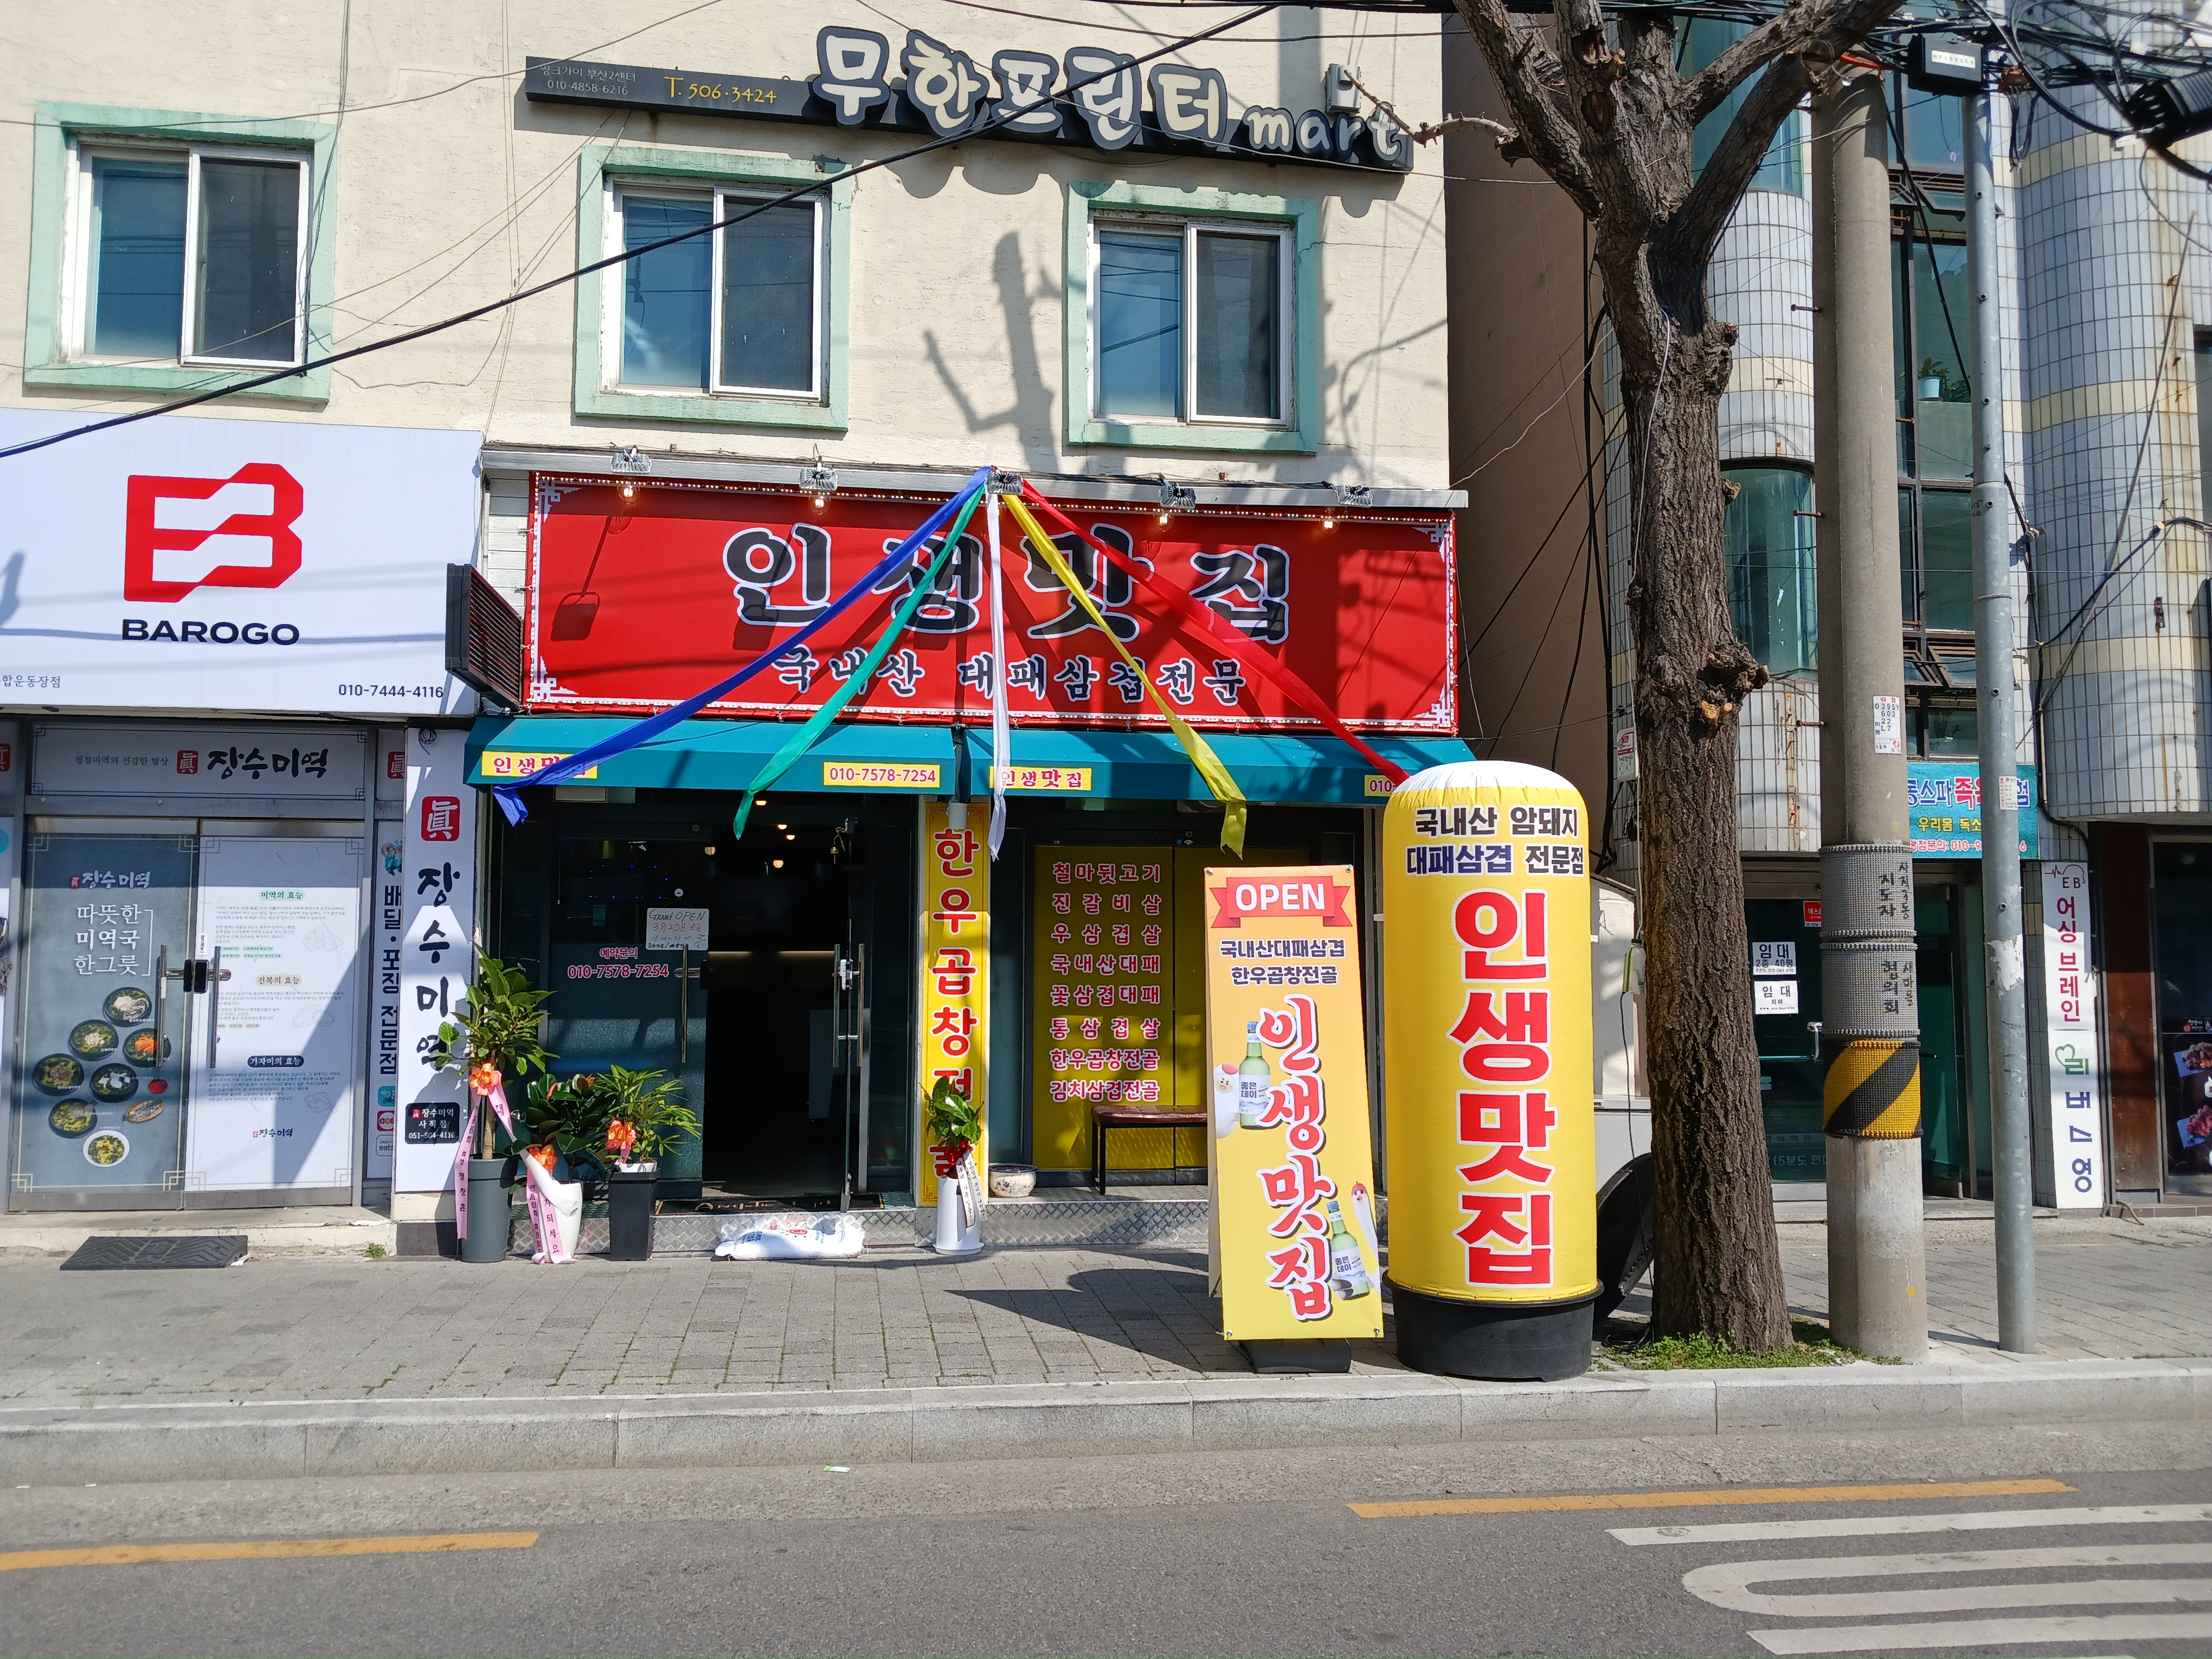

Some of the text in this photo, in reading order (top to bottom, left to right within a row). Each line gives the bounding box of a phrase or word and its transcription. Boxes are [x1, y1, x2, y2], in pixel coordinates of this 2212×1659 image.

[587, 69, 636, 82] 부산2센터
[547, 80, 628, 95] 010-4858-6216
[818, 26, 1227, 150] 무한프린터
[723, 523, 1289, 644] 인생맛집
[122, 618, 300, 646] BAROGO
[0, 674, 60, 688] 합운동장점
[773, 645, 925, 697] 국내산
[338, 684, 444, 698] 010-7444-4116
[207, 747, 329, 779] 장수미역
[829, 767, 937, 783] 010-7578-7254
[1001, 769, 1083, 788] 인생맛집
[1414, 805, 1579, 838] 국내산 암돼지
[1918, 817, 1953, 832] 우리몸
[1406, 844, 1585, 876] 대패삼겹 전문점
[82, 870, 151, 889] 장수미역
[1052, 862, 1161, 885] 철마뒷고기
[261, 891, 285, 899] 미역의
[1236, 883, 1325, 911] OPEN
[76, 903, 143, 925] 따뜻한
[676, 911, 706, 922] OPEN
[75, 929, 141, 950] 미역국
[1220, 939, 1346, 960] 국내산대패삼겹
[599, 947, 638, 960] 예약문의
[1759, 944, 1789, 959] 임대
[2057, 896, 2081, 1022] 어싱 브레인
[74, 954, 139, 975] 한그릇
[568, 964, 669, 980] 010-7578-7254
[1051, 954, 1161, 975] 국내산대패
[1756, 959, 1769, 968] 2층
[258, 976, 281, 985] 전복의
[1230, 964, 1339, 986] 한우곱창전골
[1050, 984, 1161, 1007] 꽃삼겹대패
[1763, 986, 1791, 998] 임대
[380, 1005, 398, 1075] 전문점
[249, 1057, 301, 1066] 가자미의 효능
[1050, 1049, 1160, 1071] 한우곱창전골
[1050, 1079, 1160, 1103] 김치삼겹전골
[1448, 889, 1557, 1287] 인생맛집
[421, 1108, 454, 1117] 장수미역
[1257, 994, 1337, 1321] 인생맛집
